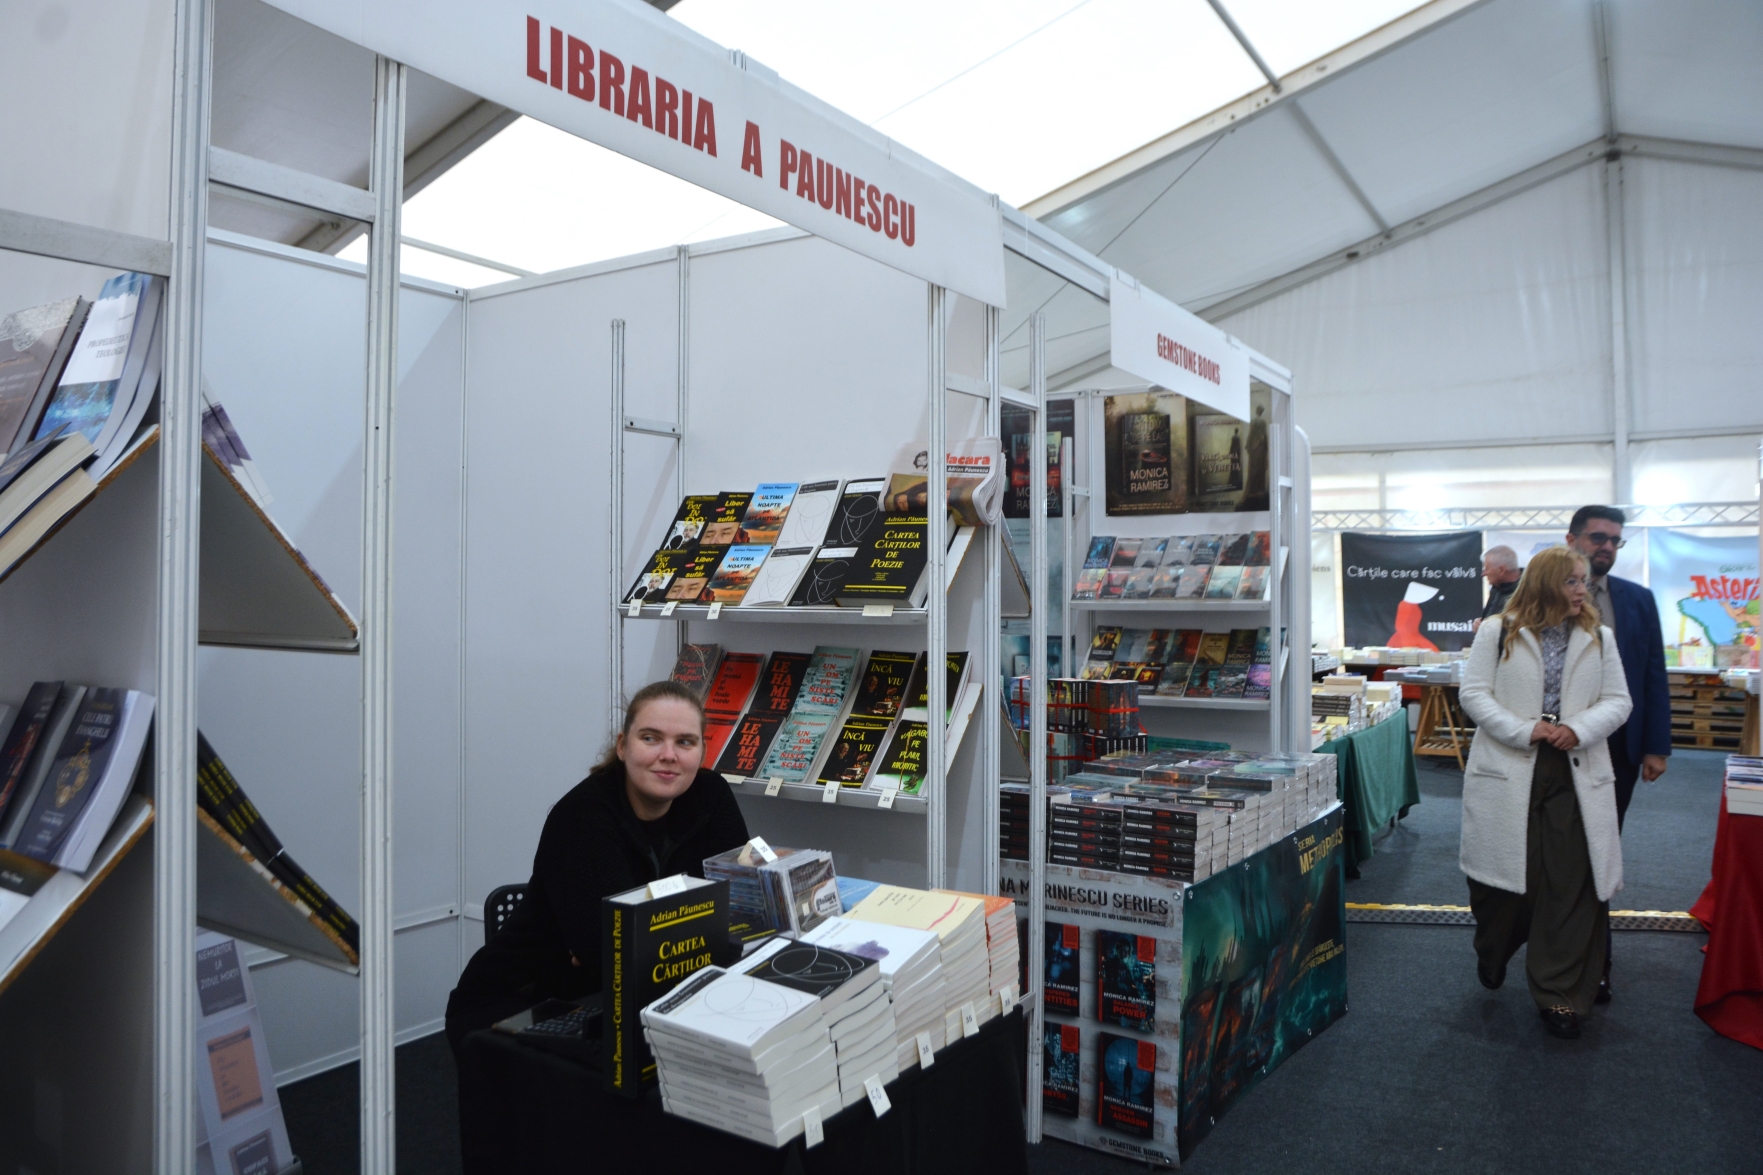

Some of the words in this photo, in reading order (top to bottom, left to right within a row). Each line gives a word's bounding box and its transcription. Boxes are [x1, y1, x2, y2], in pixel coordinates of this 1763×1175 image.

[526, 14, 717, 158] LIBRARIA
[741, 120, 763, 178] A
[780, 138, 916, 247] PAUNESCU
[1157, 332, 1197, 374] GEMSTONE
[1198, 354, 1221, 386] BOOKS
[946, 454, 990, 466] lacara
[1130, 467, 1168, 480] MONICA
[1016, 486, 1057, 498] MOCA
[1130, 480, 1169, 493] RAMIREZ
[1016, 500, 1057, 510] RAEZ
[884, 530, 920, 539] CARTEA
[870, 559, 904, 568] POEZIE
[1391, 570, 1419, 578] care
[1422, 566, 1442, 578] fac
[1445, 566, 1476, 578] vâlvă
[1690, 575, 1760, 600] Asteri
[1427, 620, 1473, 632] musai
[771, 660, 790, 672] LE
[870, 662, 892, 674] ÎNCĂ
[770, 674, 792, 686] HA
[888, 677, 904, 686] VIU
[770, 686, 790, 698] MI
[770, 698, 790, 710] TE
[741, 722, 762, 734] LE
[739, 734, 760, 746] HA
[843, 731, 866, 741] ÎNCĂ
[858, 744, 874, 752] VIU
[911, 740, 921, 748] PE
[737, 746, 756, 758] MI
[736, 758, 756, 770] TE
[1297, 834, 1316, 851] SERIA
[1020, 878, 1108, 907] MRINESCU
[1112, 892, 1168, 915] SERIES
[650, 910, 677, 924] Adrian
[680, 900, 714, 918] Păunescu
[1080, 910, 1100, 918] FUTURE
[1116, 914, 1137, 924] LONGER
[613, 909, 622, 938] POEZIE
[614, 938, 622, 949] DE
[658, 936, 706, 960] CARTEA
[652, 952, 712, 984] CĂRȚILOR
[1052, 982, 1079, 992] RAMIREZ
[1044, 995, 1078, 1008] NTITIES
[1104, 992, 1127, 1001] MONICA
[1128, 996, 1154, 1006] RAMIREZ
[1112, 1006, 1147, 1019] POWER
[614, 1068, 622, 1088] Adrian
[1104, 1095, 1126, 1106] MONICA
[1126, 1102, 1153, 1114] RAMIREZ
[1112, 1112, 1148, 1128] ASSASSIN
[1108, 1138, 1142, 1154] GEMSTONE
